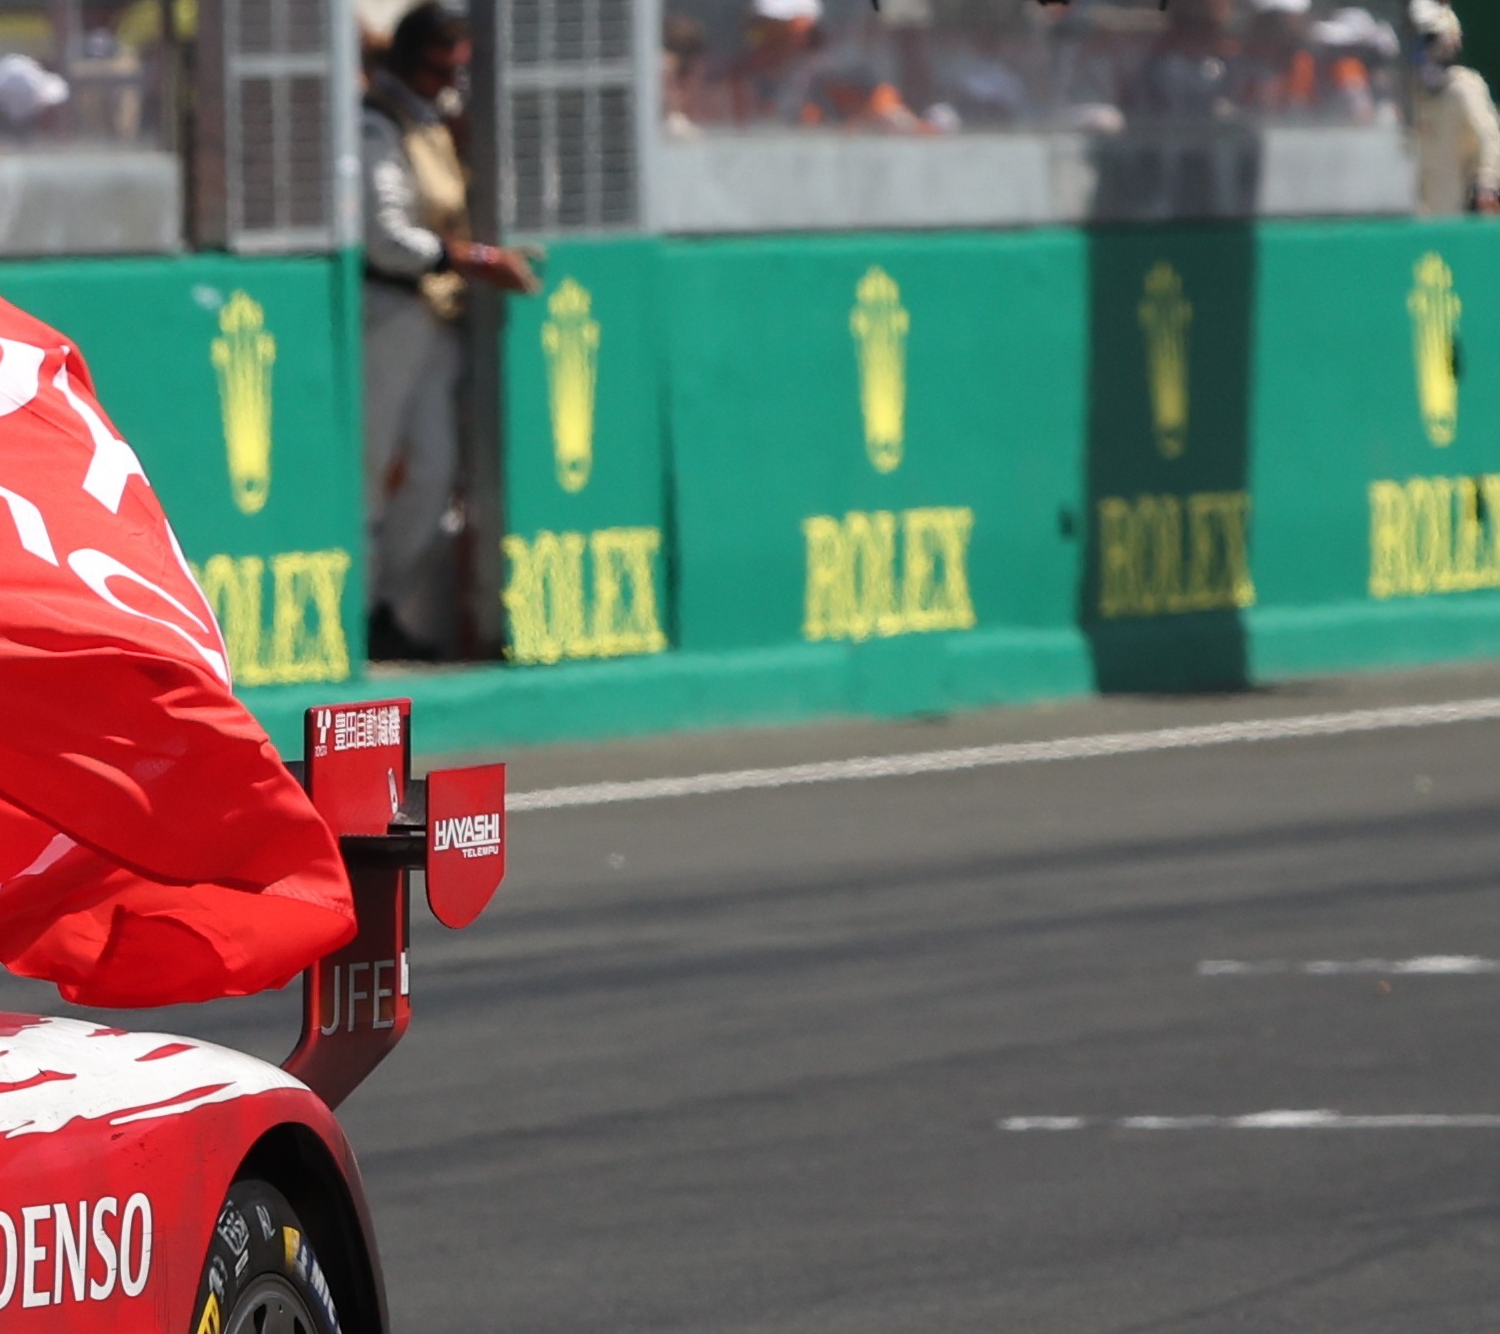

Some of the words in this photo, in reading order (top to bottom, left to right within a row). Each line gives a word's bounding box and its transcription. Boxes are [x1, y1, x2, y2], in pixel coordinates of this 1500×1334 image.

[803, 507, 975, 642] ROLEX
[200, 549, 351, 685] OLEX
[434, 814, 501, 851] HAYASHI
[462, 845, 499, 859] TELEMPU
[320, 960, 396, 1036] JFE
